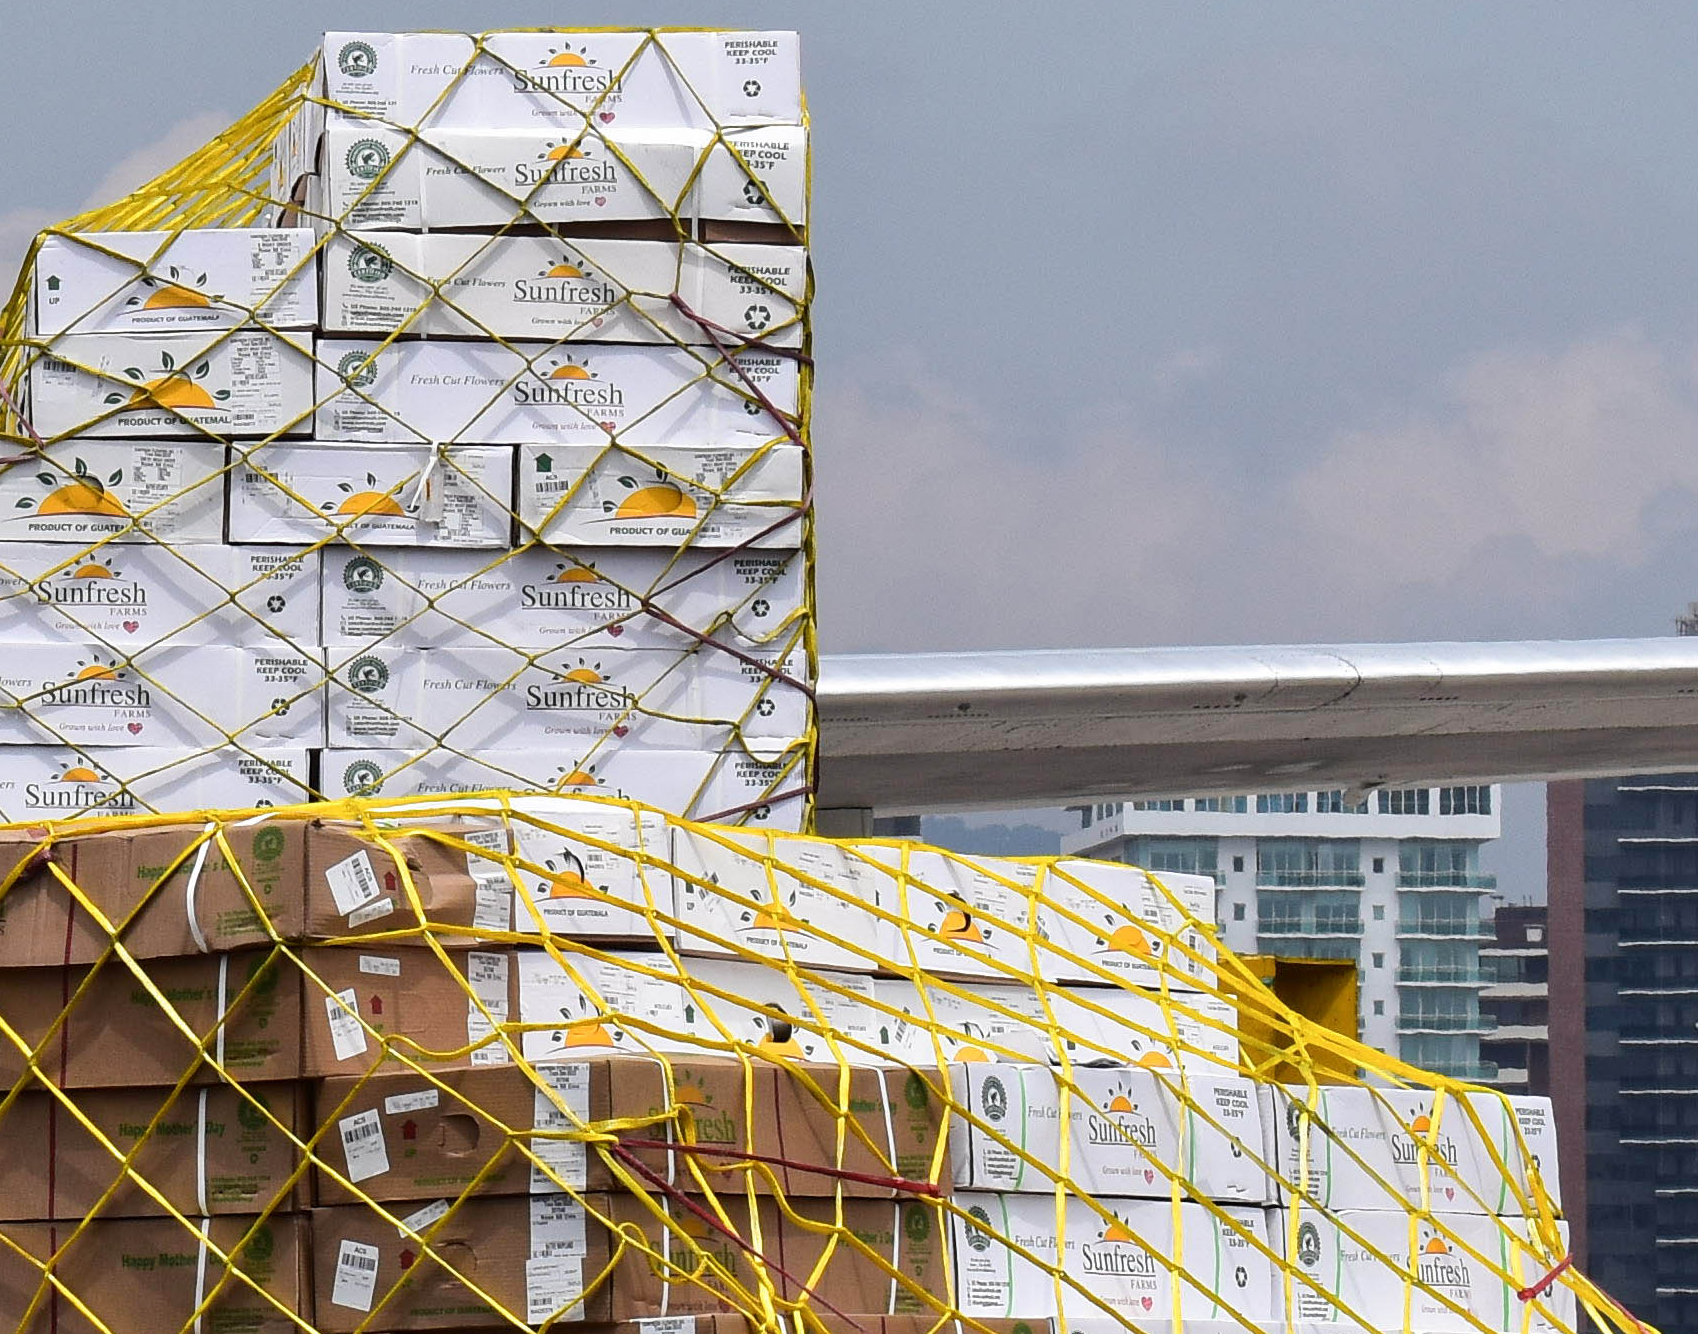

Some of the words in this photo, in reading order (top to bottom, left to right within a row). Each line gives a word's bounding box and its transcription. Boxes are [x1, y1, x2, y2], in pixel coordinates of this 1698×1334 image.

[724, 40, 778, 48] PERISHABLE
[726, 49, 748, 57] KEEP
[752, 49, 777, 57] COOL
[582, 185, 617, 193] FARMS
[514, 280, 614, 303] Sunfresh
[411, 375, 440, 385] Fresh
[443, 375, 461, 385] Cut
[514, 382, 623, 404] Sunfresh
[587, 409, 625, 417] FARMS
[118, 417, 160, 427] PRODUCT
[164, 417, 177, 426] OF
[29, 523, 73, 532] PRODUCT
[76, 523, 88, 532] OF
[610, 527, 653, 535] PRODUCT
[656, 527, 668, 535] OF
[736, 568, 758, 576] KEEP
[38, 581, 146, 604] Sunfresh
[521, 585, 630, 608] Sunfresh
[110, 608, 147, 616] FARMS
[254, 658, 308, 667] PERISHABLE
[423, 679, 452, 689] Fresh
[454, 679, 473, 689] Cut
[42, 683, 150, 705] Sunfresh
[527, 686, 636, 708] Sunfresh
[114, 710, 151, 718] FARMS
[88, 722, 104, 731] with
[1214, 1088, 1248, 1098] PERISHABLE
[1028, 1105, 1045, 1117] Fresh
[205, 1123, 225, 1137] Day
[1089, 1115, 1156, 1144] Sunfresh
[1015, 1235, 1034, 1247] Fresh
[121, 1253, 155, 1271] Happy
[1083, 1244, 1155, 1273] Sunfresh
[1131, 1279, 1157, 1289] FARMS
